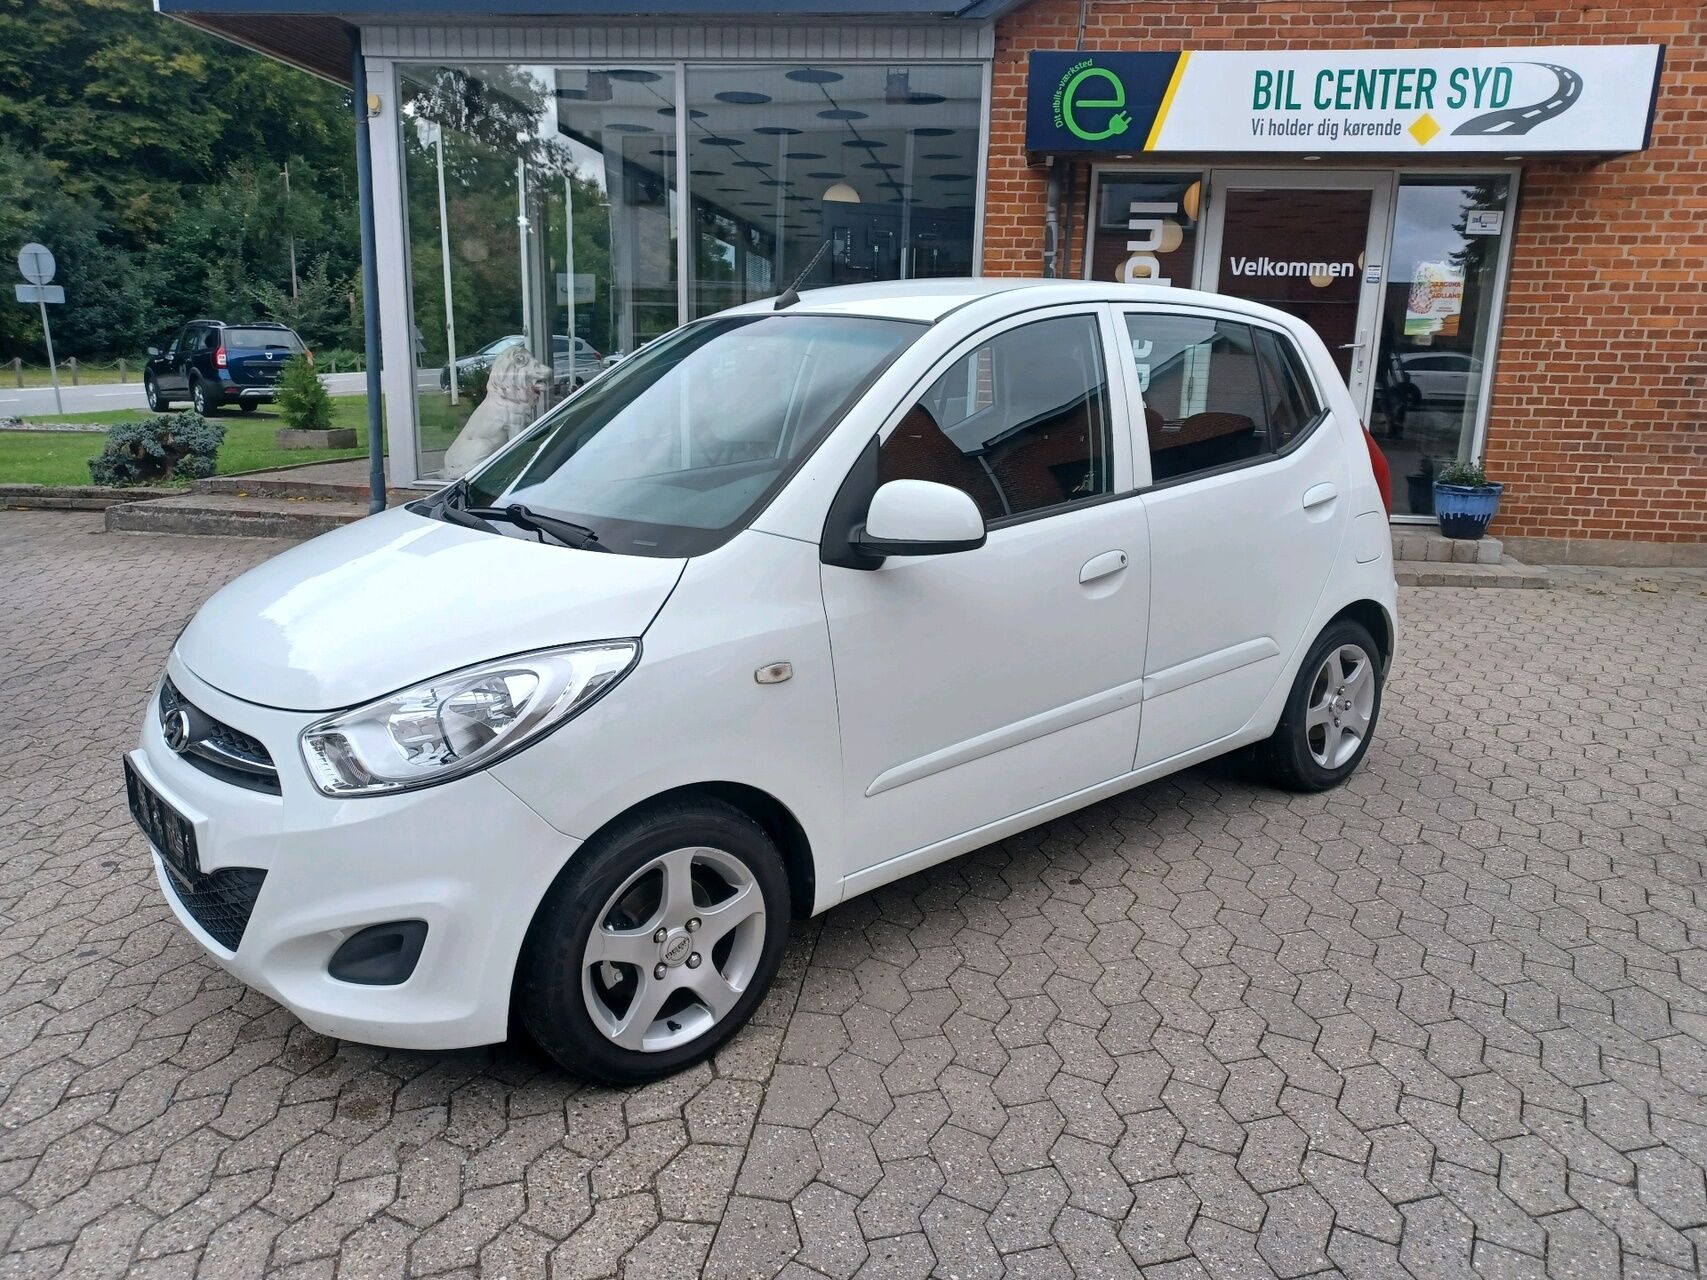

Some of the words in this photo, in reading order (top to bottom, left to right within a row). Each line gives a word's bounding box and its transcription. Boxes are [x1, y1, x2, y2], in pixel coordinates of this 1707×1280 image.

[1252, 69, 1302, 110] BIL
[1313, 68, 1438, 110] CENTER
[1446, 66, 1513, 110] SYD
[1251, 118, 1264, 136] Vi
[1268, 118, 1314, 136] holder
[1317, 118, 1339, 141] dig
[1343, 117, 1402, 136] kørende
[1230, 256, 1355, 277] Velkommen
